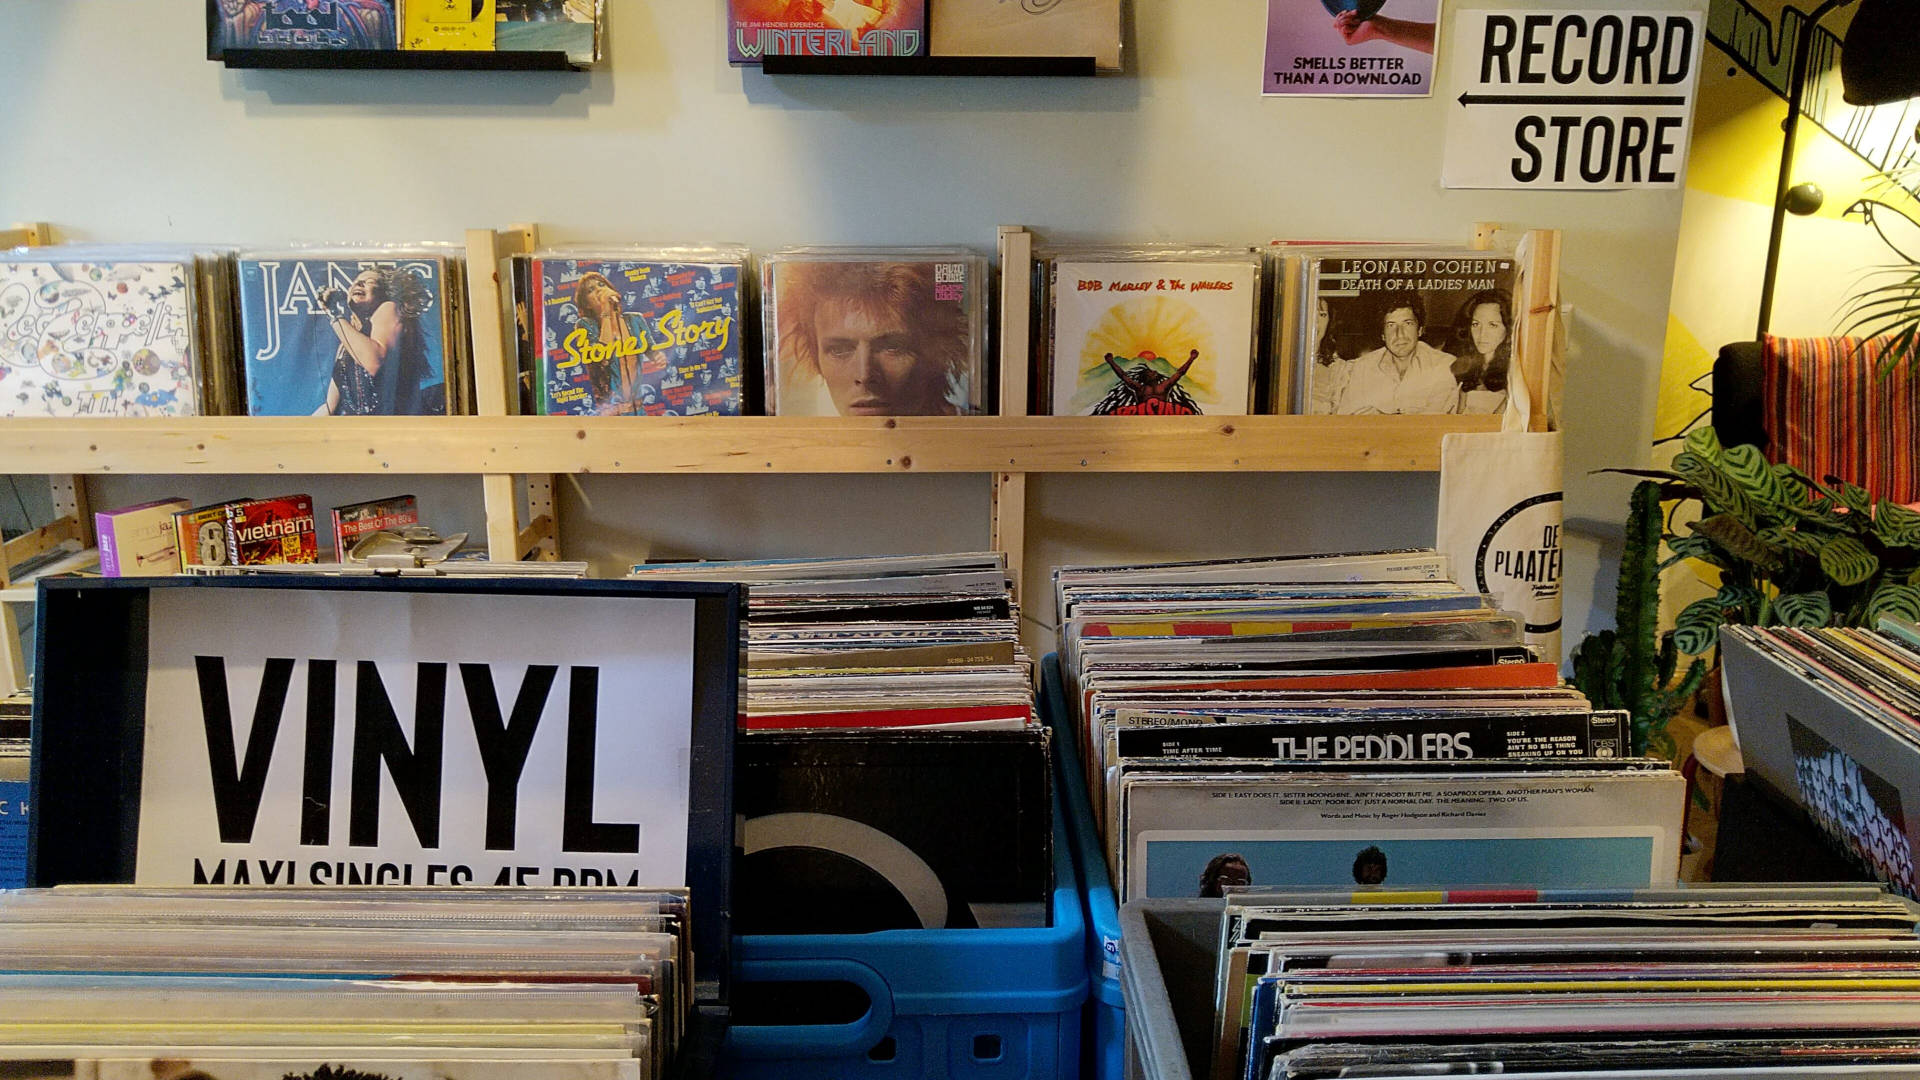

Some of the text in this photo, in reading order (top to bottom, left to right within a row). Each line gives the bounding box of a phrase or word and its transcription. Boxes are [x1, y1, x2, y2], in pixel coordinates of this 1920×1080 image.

[736, 28, 920, 58] WINTERLAND
[1479, 14, 1694, 85] RECORD
[1293, 57, 1404, 70] SMELLS BETTER
[1274, 72, 1422, 85] THAN A DOWNLOAD
[1511, 115, 1683, 183] STORE
[1341, 260, 1497, 275] LEONARD COHEN
[1077, 279, 1103, 291] BOB
[1108, 280, 1153, 292] MARLEY
[1155, 279, 1167, 290] &
[1190, 280, 1233, 292] WAILERS
[1340, 279, 1495, 290] DEATH OF A LADIES' MAN
[557, 309, 732, 369] Stones Story
[343, 523, 357, 534] The
[358, 521, 373, 532] Best
[384, 517, 397, 527] The
[1543, 525, 1560, 549] DE
[1591, 716, 1617, 725] Stereo
[1272, 732, 1473, 760] THE PEDDLERS
[1594, 739, 1615, 748] CBS
[194, 655, 640, 854] VINYL
[1507, 750, 1542, 758] SNEAKING
[1382, 812, 1400, 820] Roger
[1400, 812, 1428, 820] Hodgson
